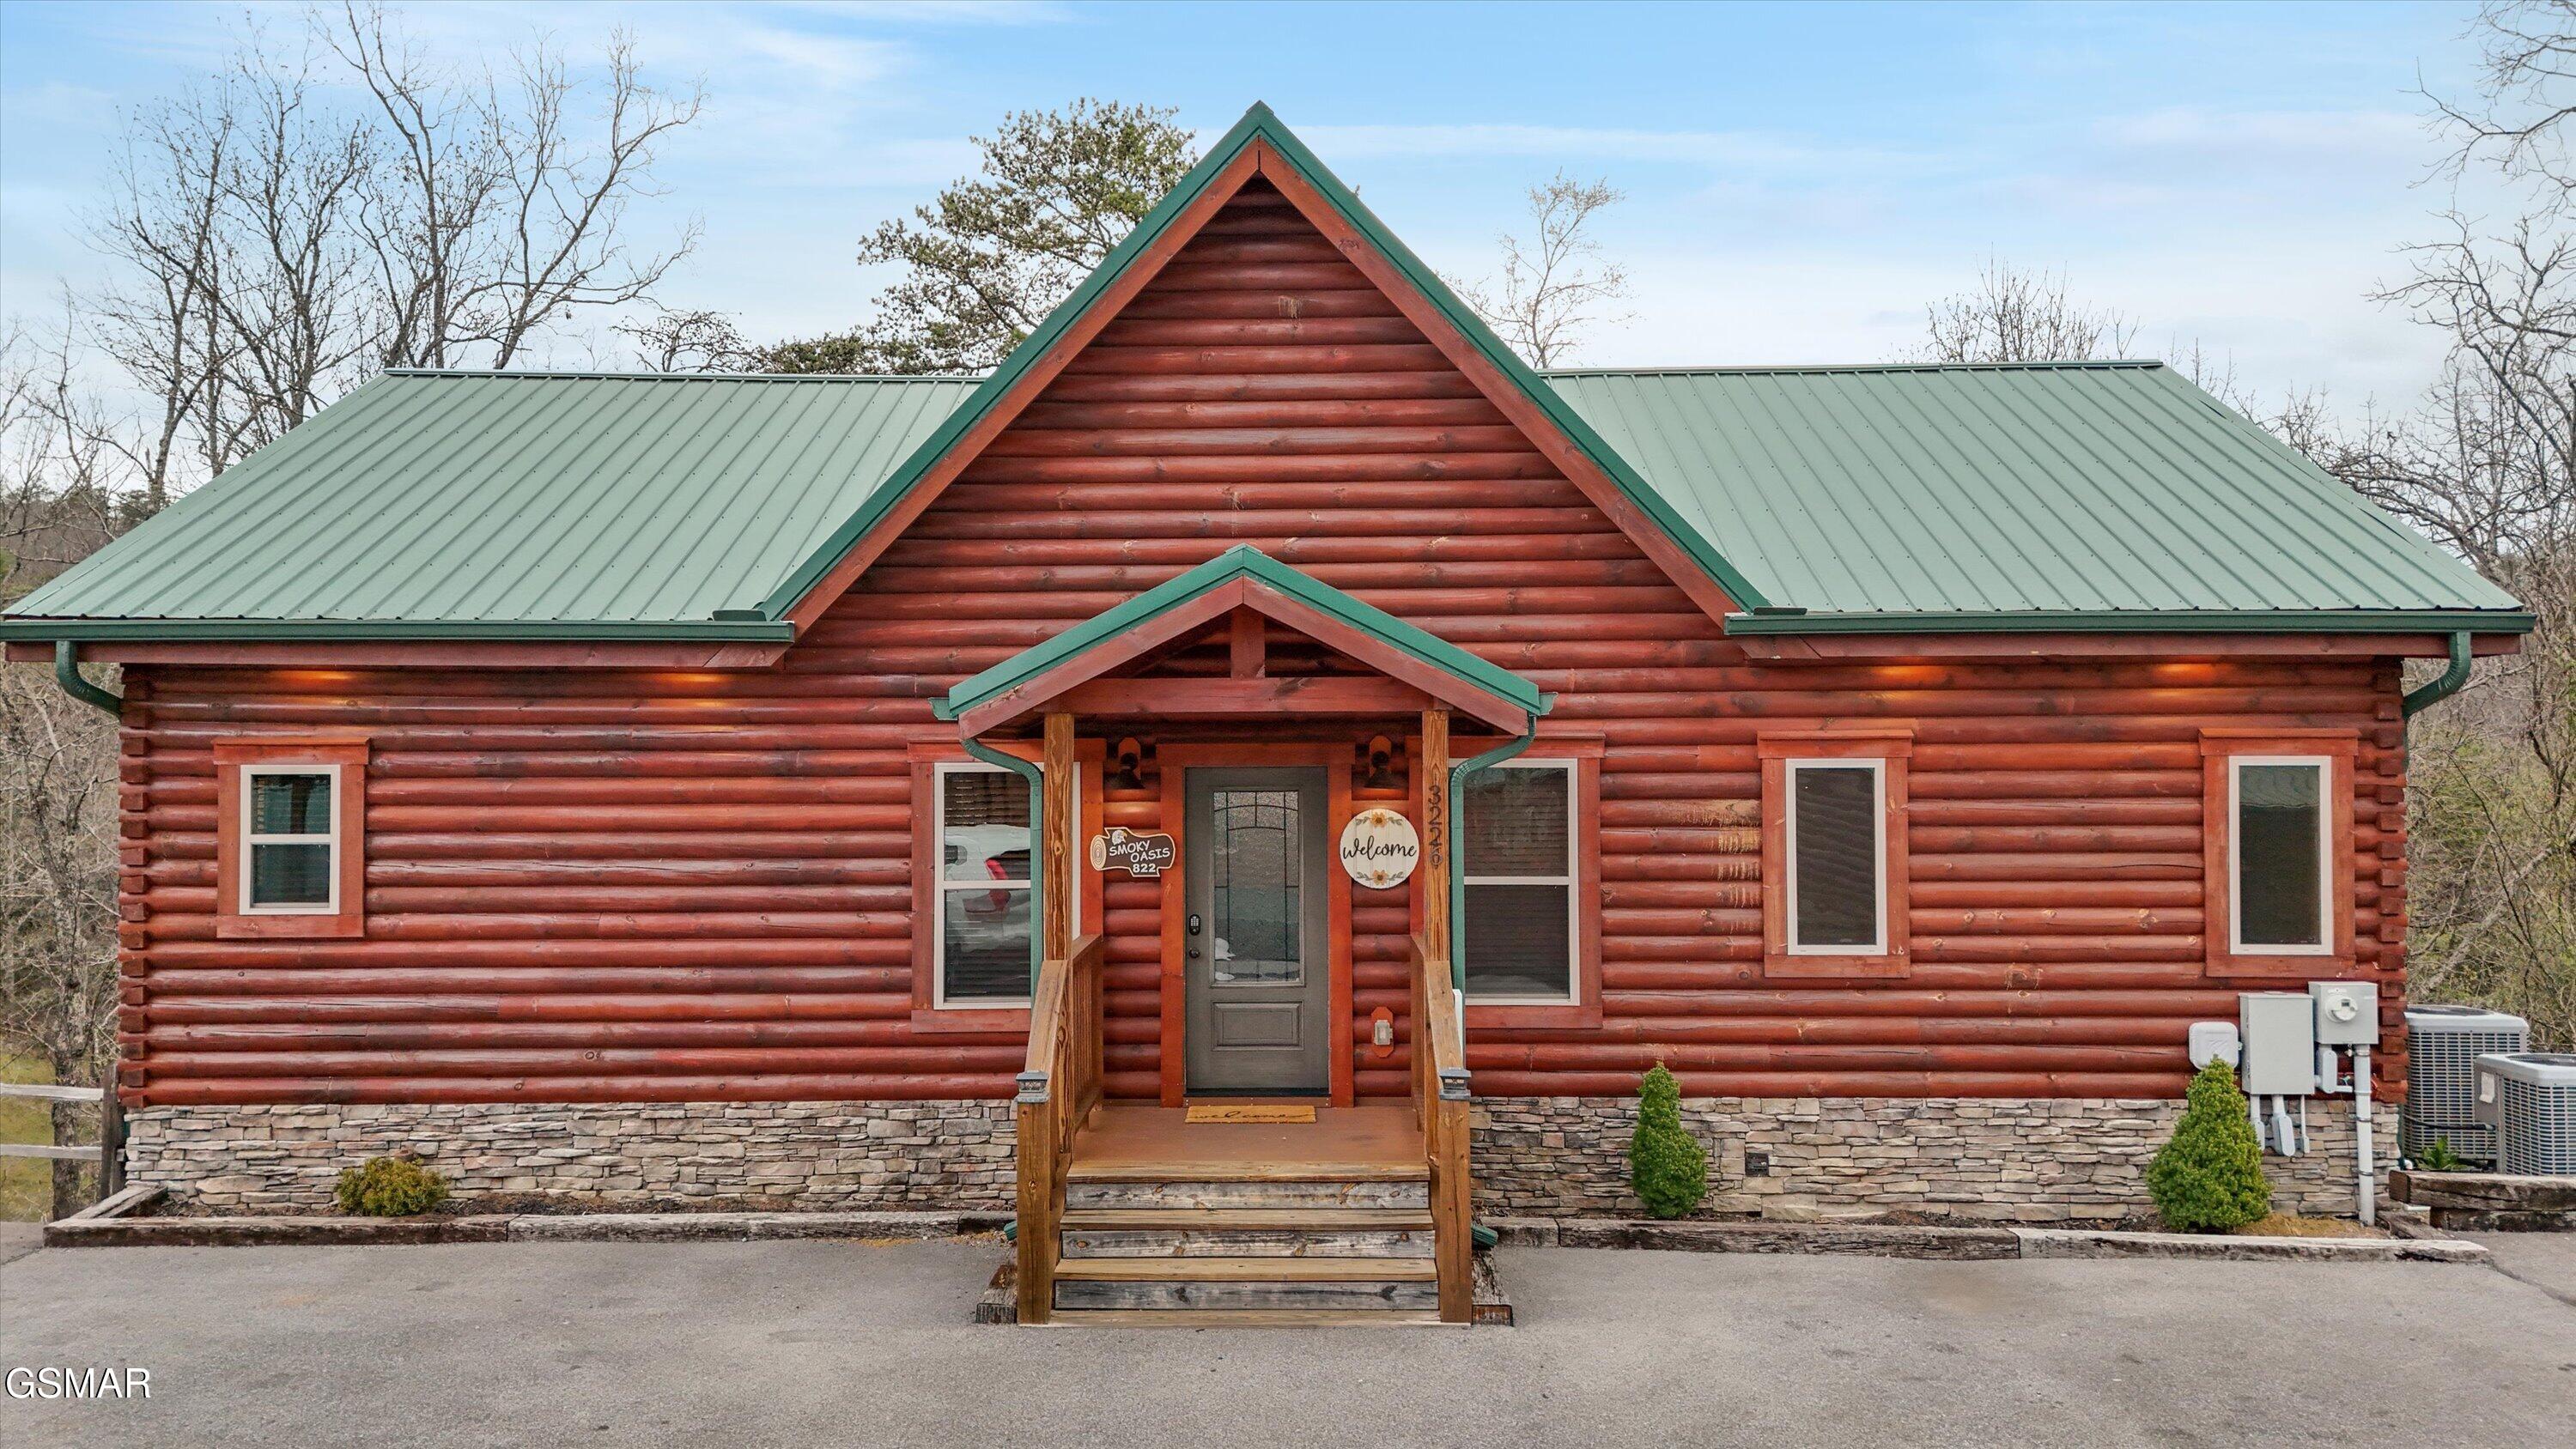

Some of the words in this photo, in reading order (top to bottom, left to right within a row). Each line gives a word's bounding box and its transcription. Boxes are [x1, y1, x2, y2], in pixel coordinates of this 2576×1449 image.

[1109, 840, 1151, 857] SMOKY
[1130, 847, 1170, 863] OASIS
[1343, 835, 1417, 860] welcome
[1133, 863, 1156, 873] 822
[1188, 1110, 1315, 1119] welcome
